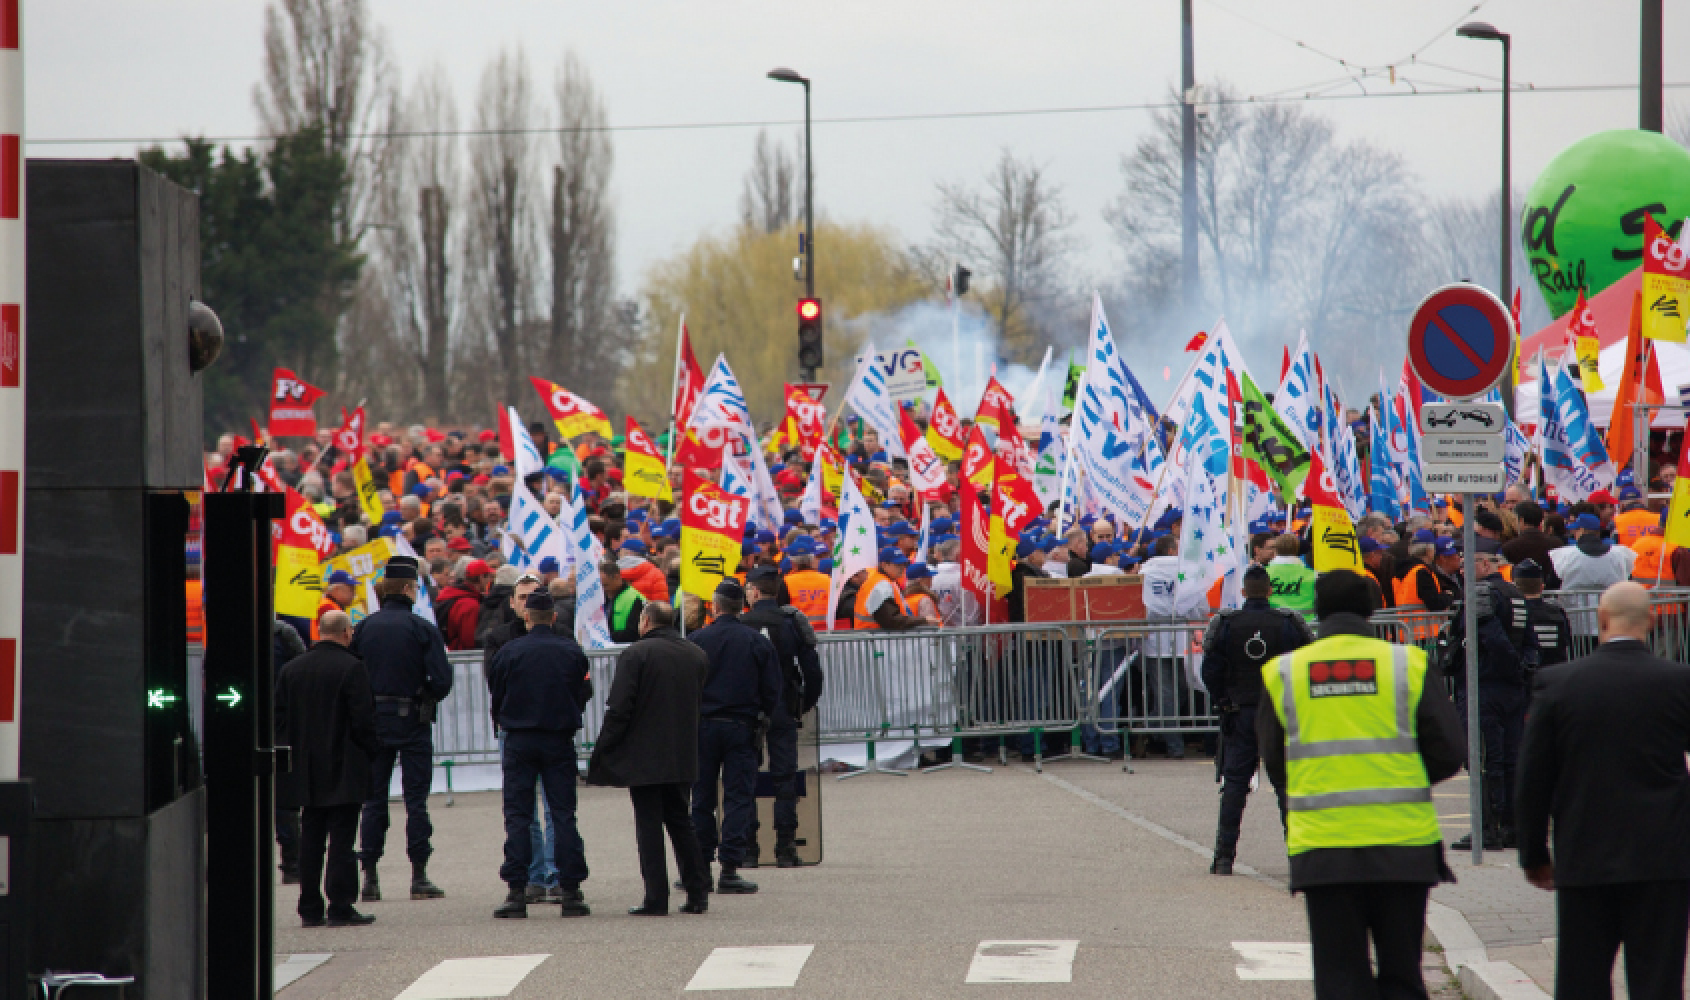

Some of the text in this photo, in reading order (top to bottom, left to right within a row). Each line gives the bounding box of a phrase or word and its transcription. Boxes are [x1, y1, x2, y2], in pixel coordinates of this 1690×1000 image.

[1649, 236, 1690, 271] cg
[1531, 256, 1588, 295] Rail
[690, 491, 743, 530] cgt
